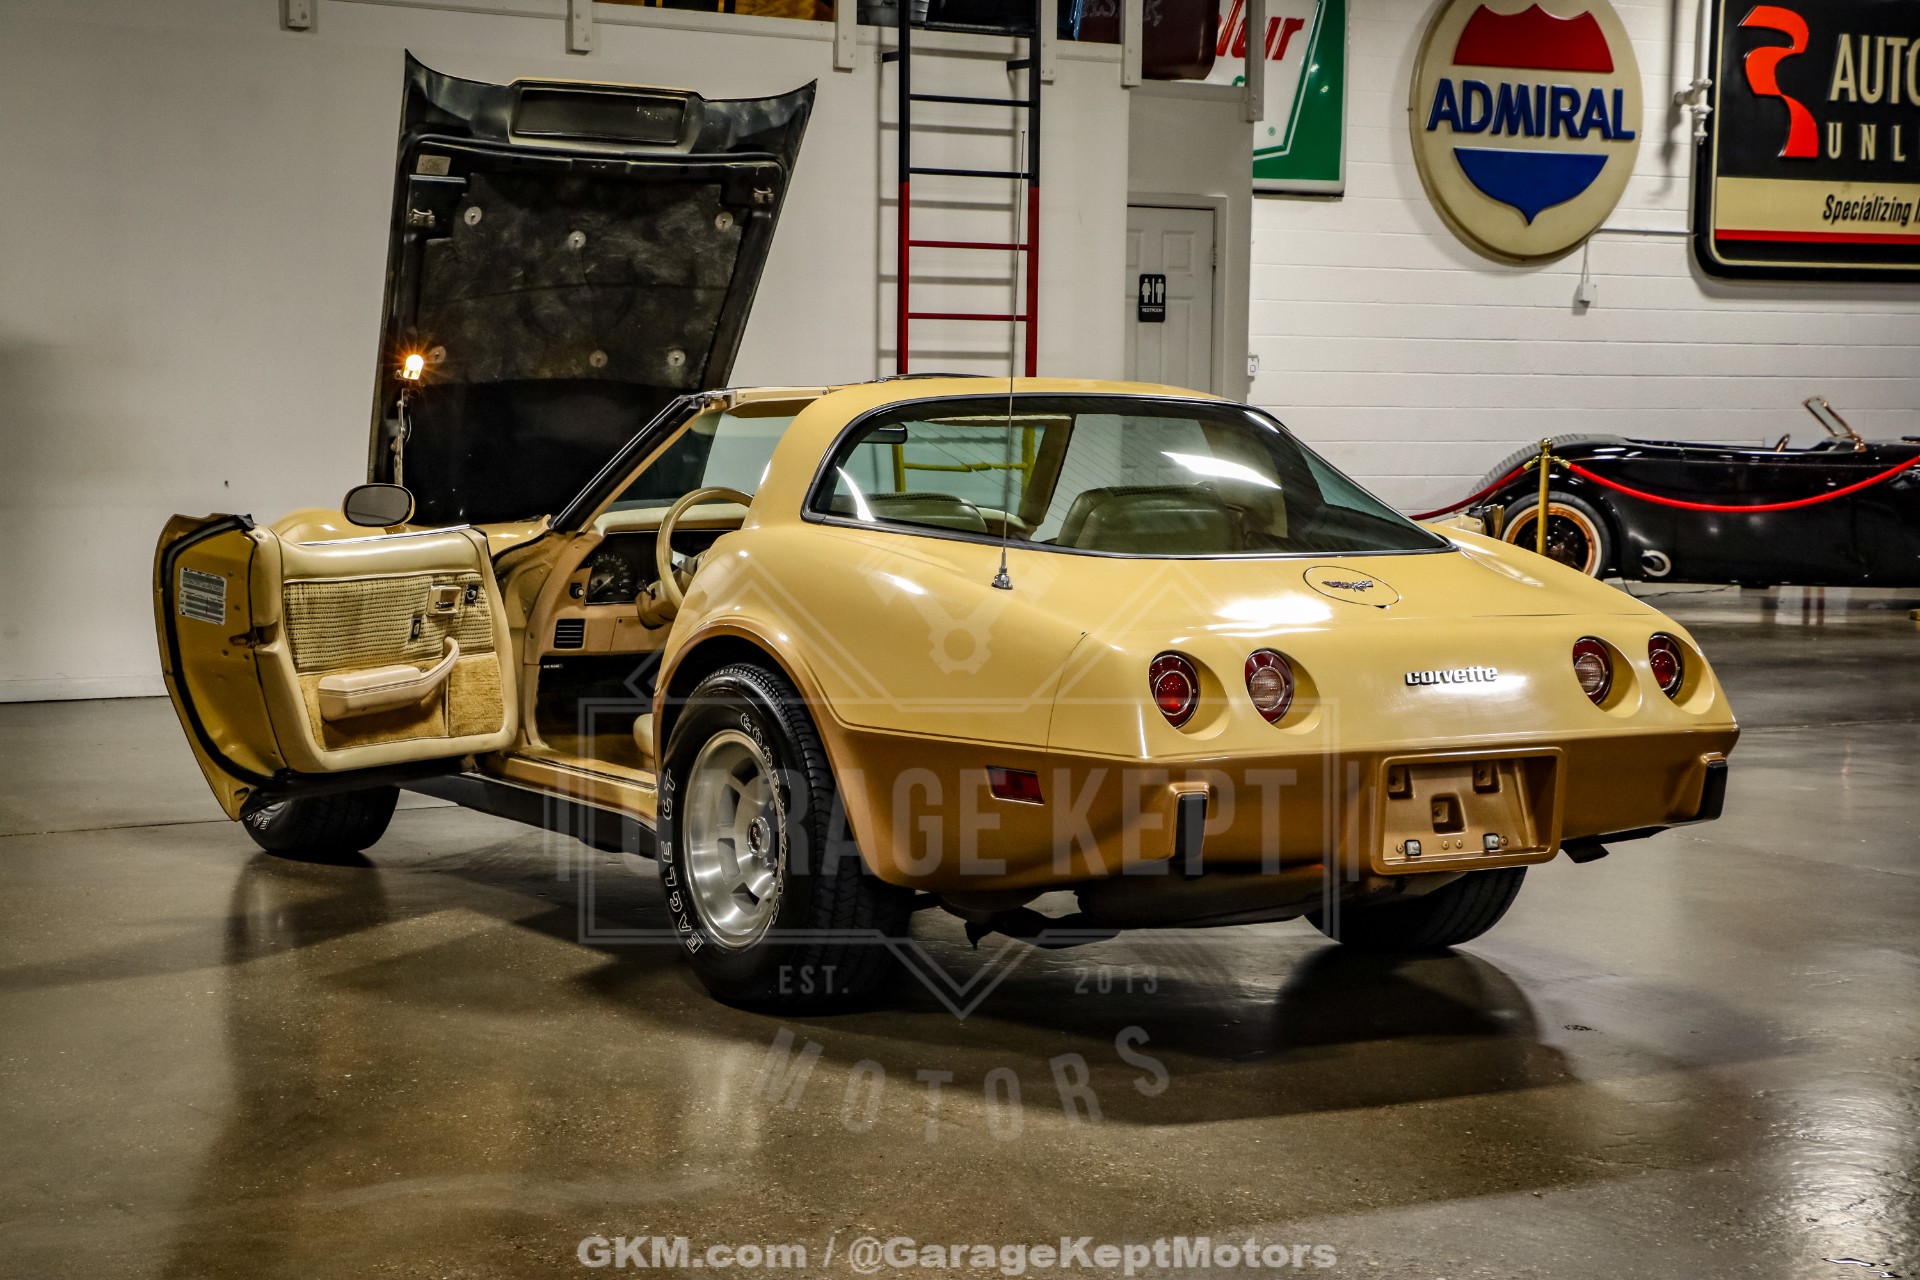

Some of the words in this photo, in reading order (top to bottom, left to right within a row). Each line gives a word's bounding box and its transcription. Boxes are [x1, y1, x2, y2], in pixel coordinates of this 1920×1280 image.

[1427, 78, 1636, 141] ADMIRAL
[1822, 193, 1912, 227] Specializing
[1405, 665, 1498, 686] corvette
[660, 840, 705, 955] EAGLE
